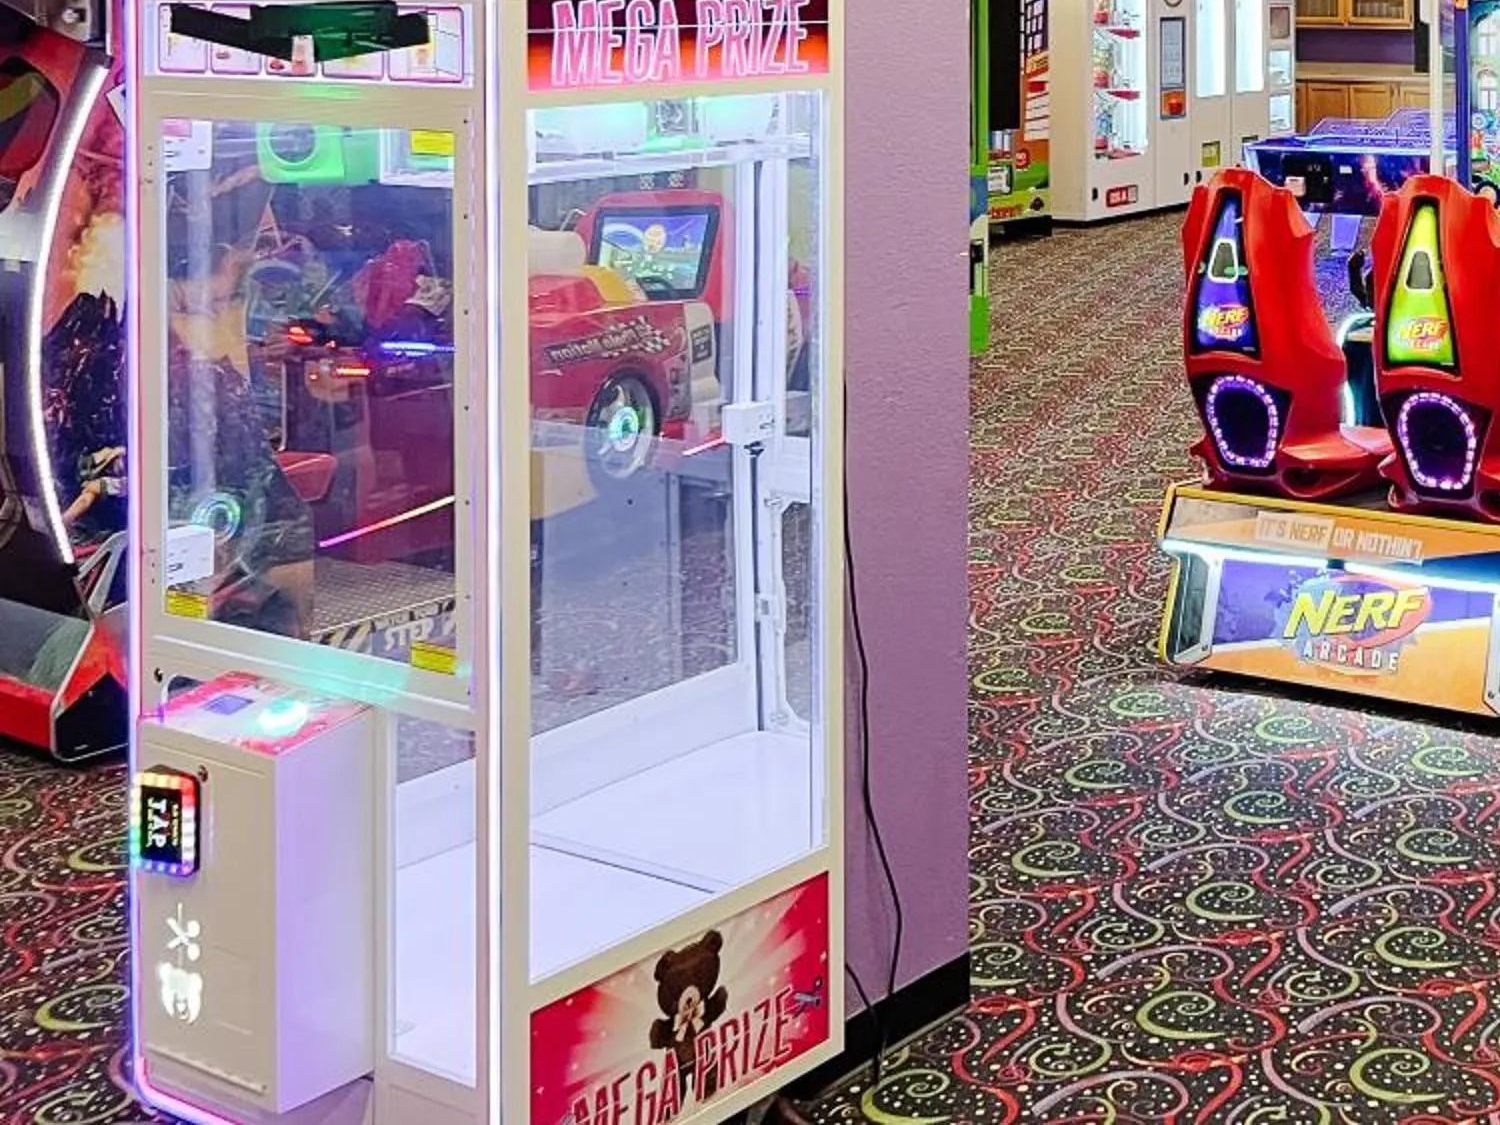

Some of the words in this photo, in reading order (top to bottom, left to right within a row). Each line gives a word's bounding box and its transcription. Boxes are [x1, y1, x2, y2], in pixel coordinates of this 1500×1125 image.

[1257, 517, 1288, 539] IT'S
[1289, 521, 1329, 546] NERF
[1332, 527, 1355, 548] OR
[1283, 588, 1426, 640] NERF
[1302, 640, 1399, 671] ARCADE
[151, 797, 169, 848] TAP
[693, 985, 793, 1102] PRIZE
